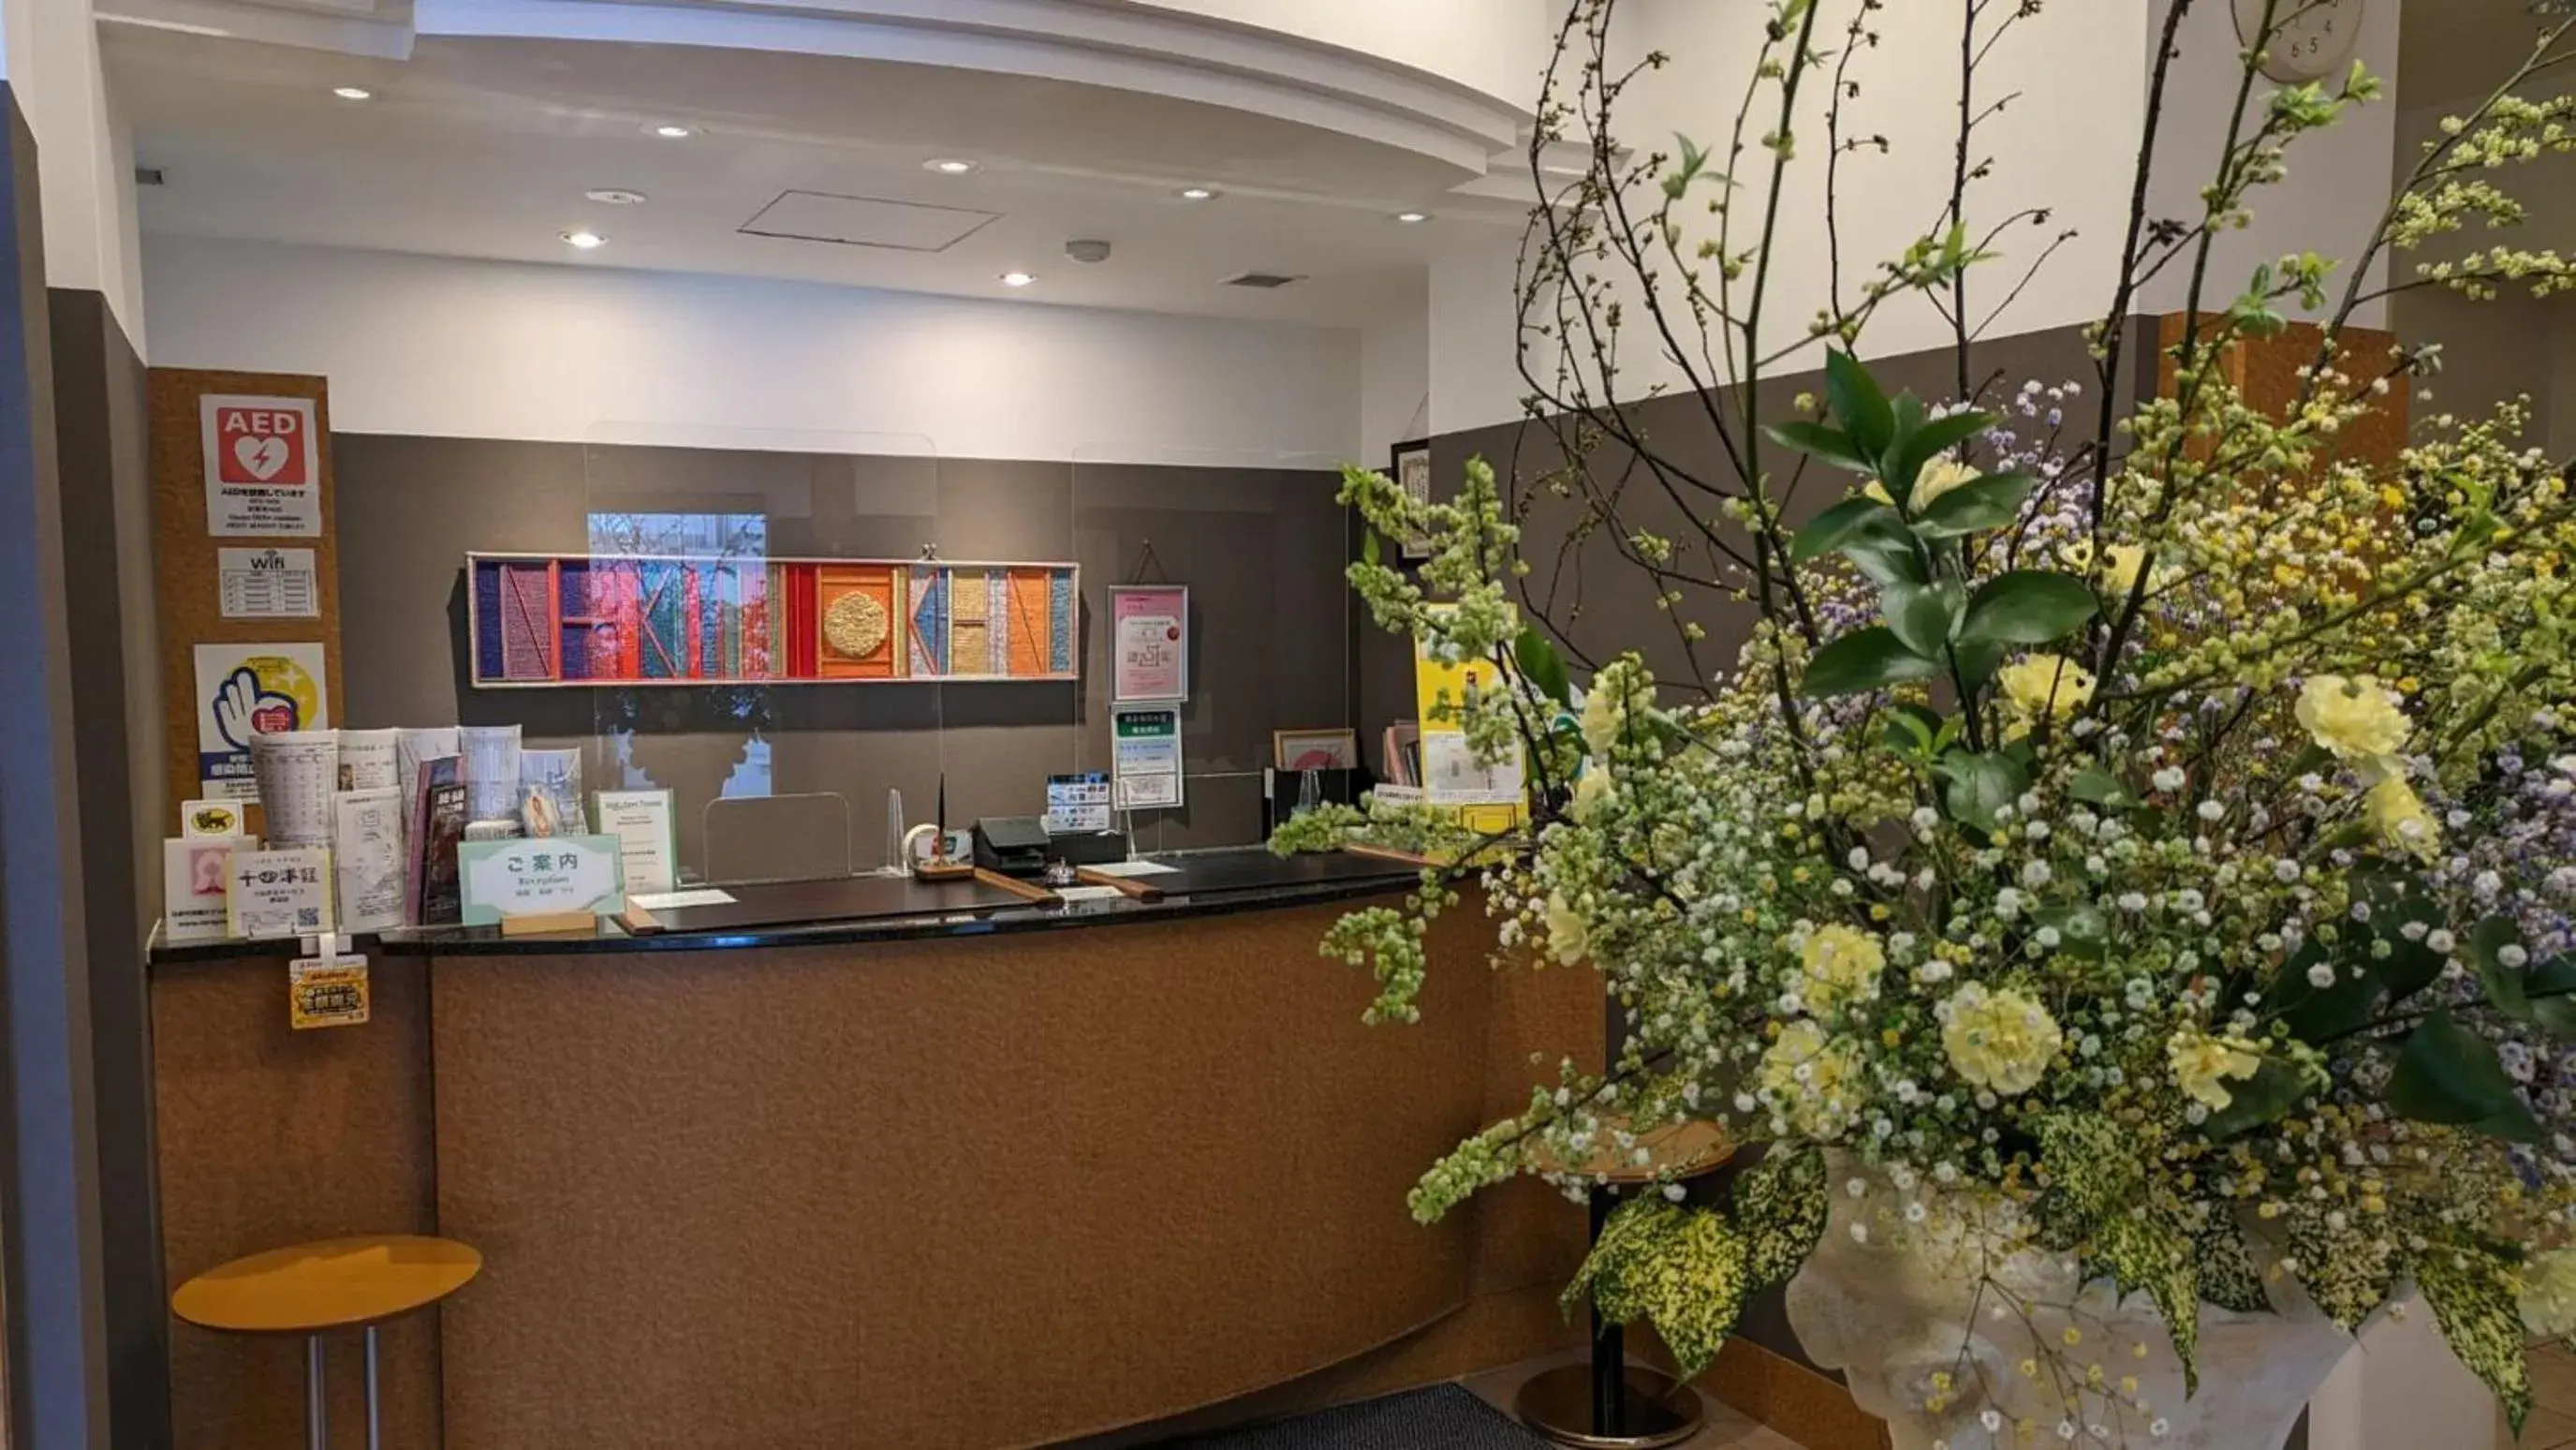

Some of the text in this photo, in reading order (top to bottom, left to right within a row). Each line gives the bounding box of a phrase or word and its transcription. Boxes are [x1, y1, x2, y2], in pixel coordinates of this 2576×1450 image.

[225, 411, 297, 435] AED
[508, 852, 579, 872] ご案内
